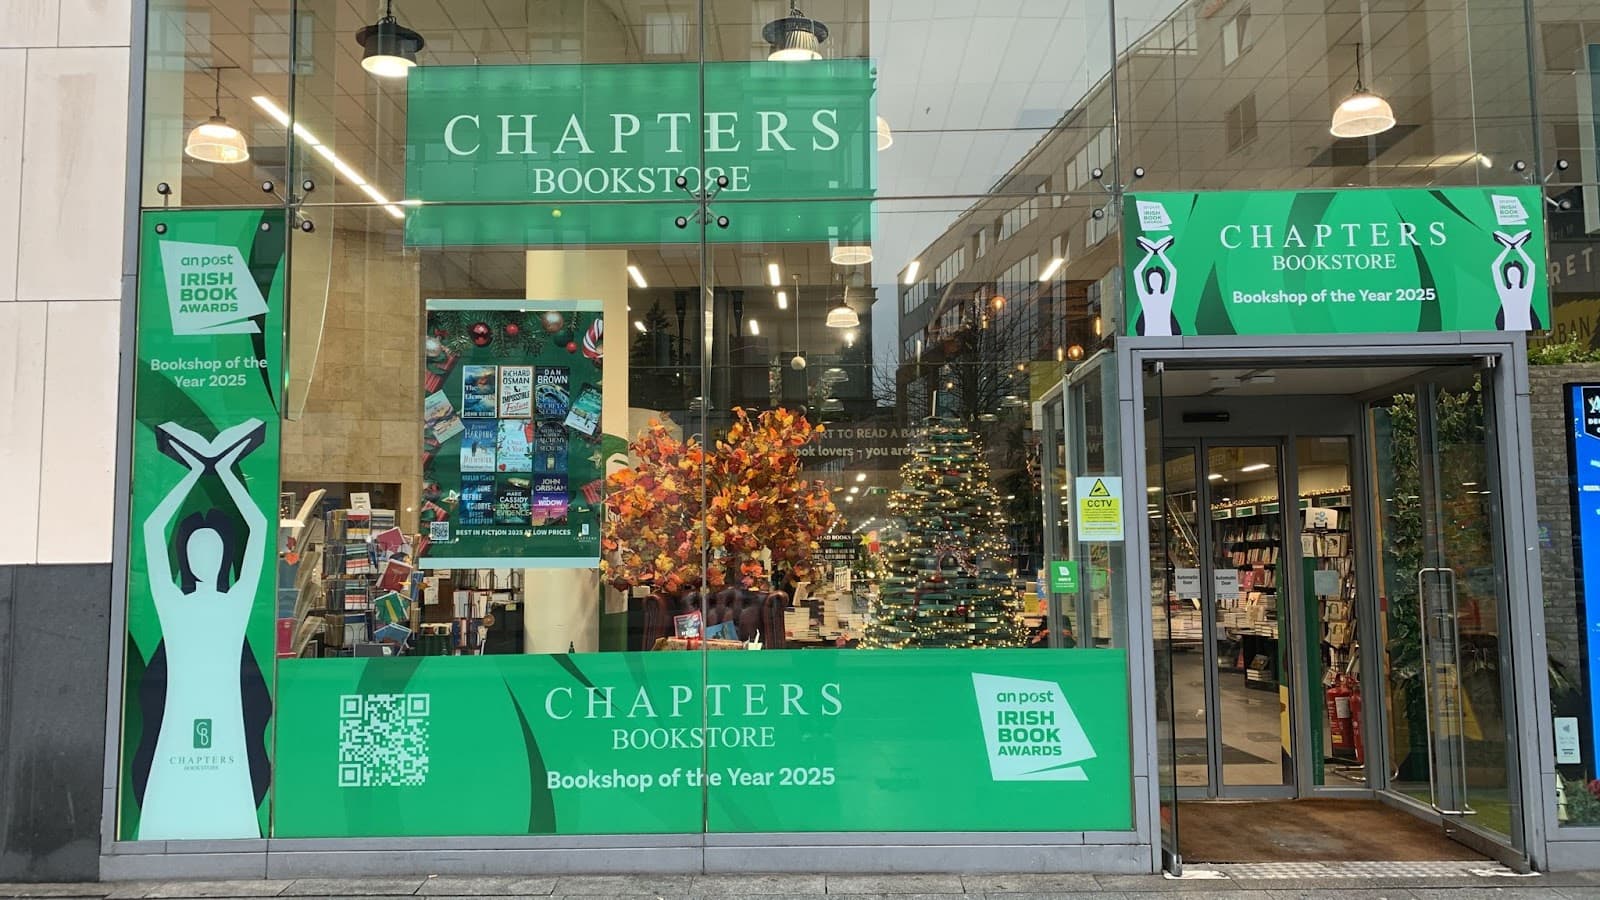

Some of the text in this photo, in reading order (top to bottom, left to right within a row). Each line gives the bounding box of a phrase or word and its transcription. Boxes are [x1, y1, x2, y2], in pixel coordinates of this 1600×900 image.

[443, 109, 840, 156] CHAPTERS
[533, 166, 751, 194] BOOKSTORE
[1220, 222, 1447, 249] CHAPTERS
[1273, 254, 1397, 271] BOOKSTORE
[180, 272, 234, 286] IRISH
[179, 287, 238, 301] BOOK
[1232, 288, 1436, 305] Bookshop of the Year 2025
[179, 303, 239, 313] AWARDS
[150, 357, 268, 371] Bookshop of the
[174, 374, 247, 388] Year 2025
[537, 375, 568, 384] BROWN
[837, 428, 853, 439] TO
[857, 428, 888, 439] READ
[890, 428, 898, 438] A
[817, 446, 853, 457] lovers
[865, 448, 888, 460] you
[462, 493, 482, 501] BEFORE
[1087, 499, 1112, 508] CCTV
[544, 682, 843, 720] CHAPTERS
[997, 690, 1054, 705] an post
[997, 710, 1055, 725] IRISH
[612, 726, 776, 750] BOOKSTORE
[998, 728, 1061, 742] BOOK
[998, 746, 1062, 756] AWARDS
[169, 755, 235, 765] CHAPTERS
[547, 767, 835, 792] Bookshop of the Year 2025
